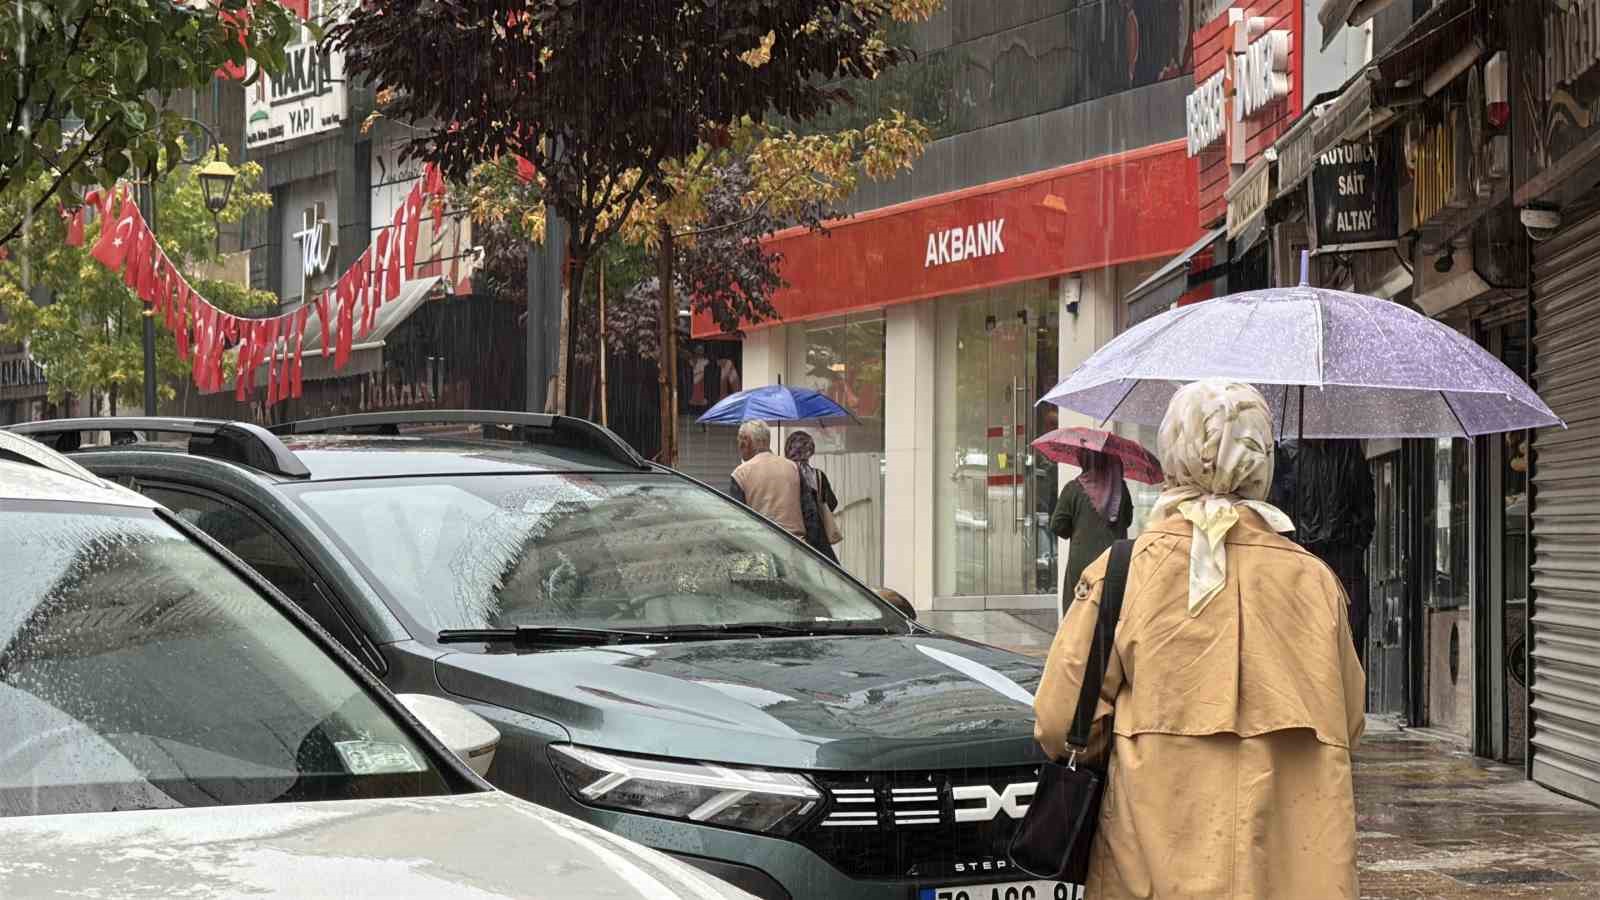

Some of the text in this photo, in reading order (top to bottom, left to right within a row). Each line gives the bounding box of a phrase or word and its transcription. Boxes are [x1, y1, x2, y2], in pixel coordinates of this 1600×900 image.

[289, 106, 314, 135] YAPI
[1338, 169, 1365, 196] SAİT
[1336, 210, 1372, 232] ALTAY
[925, 218, 1004, 268] AKBANK
